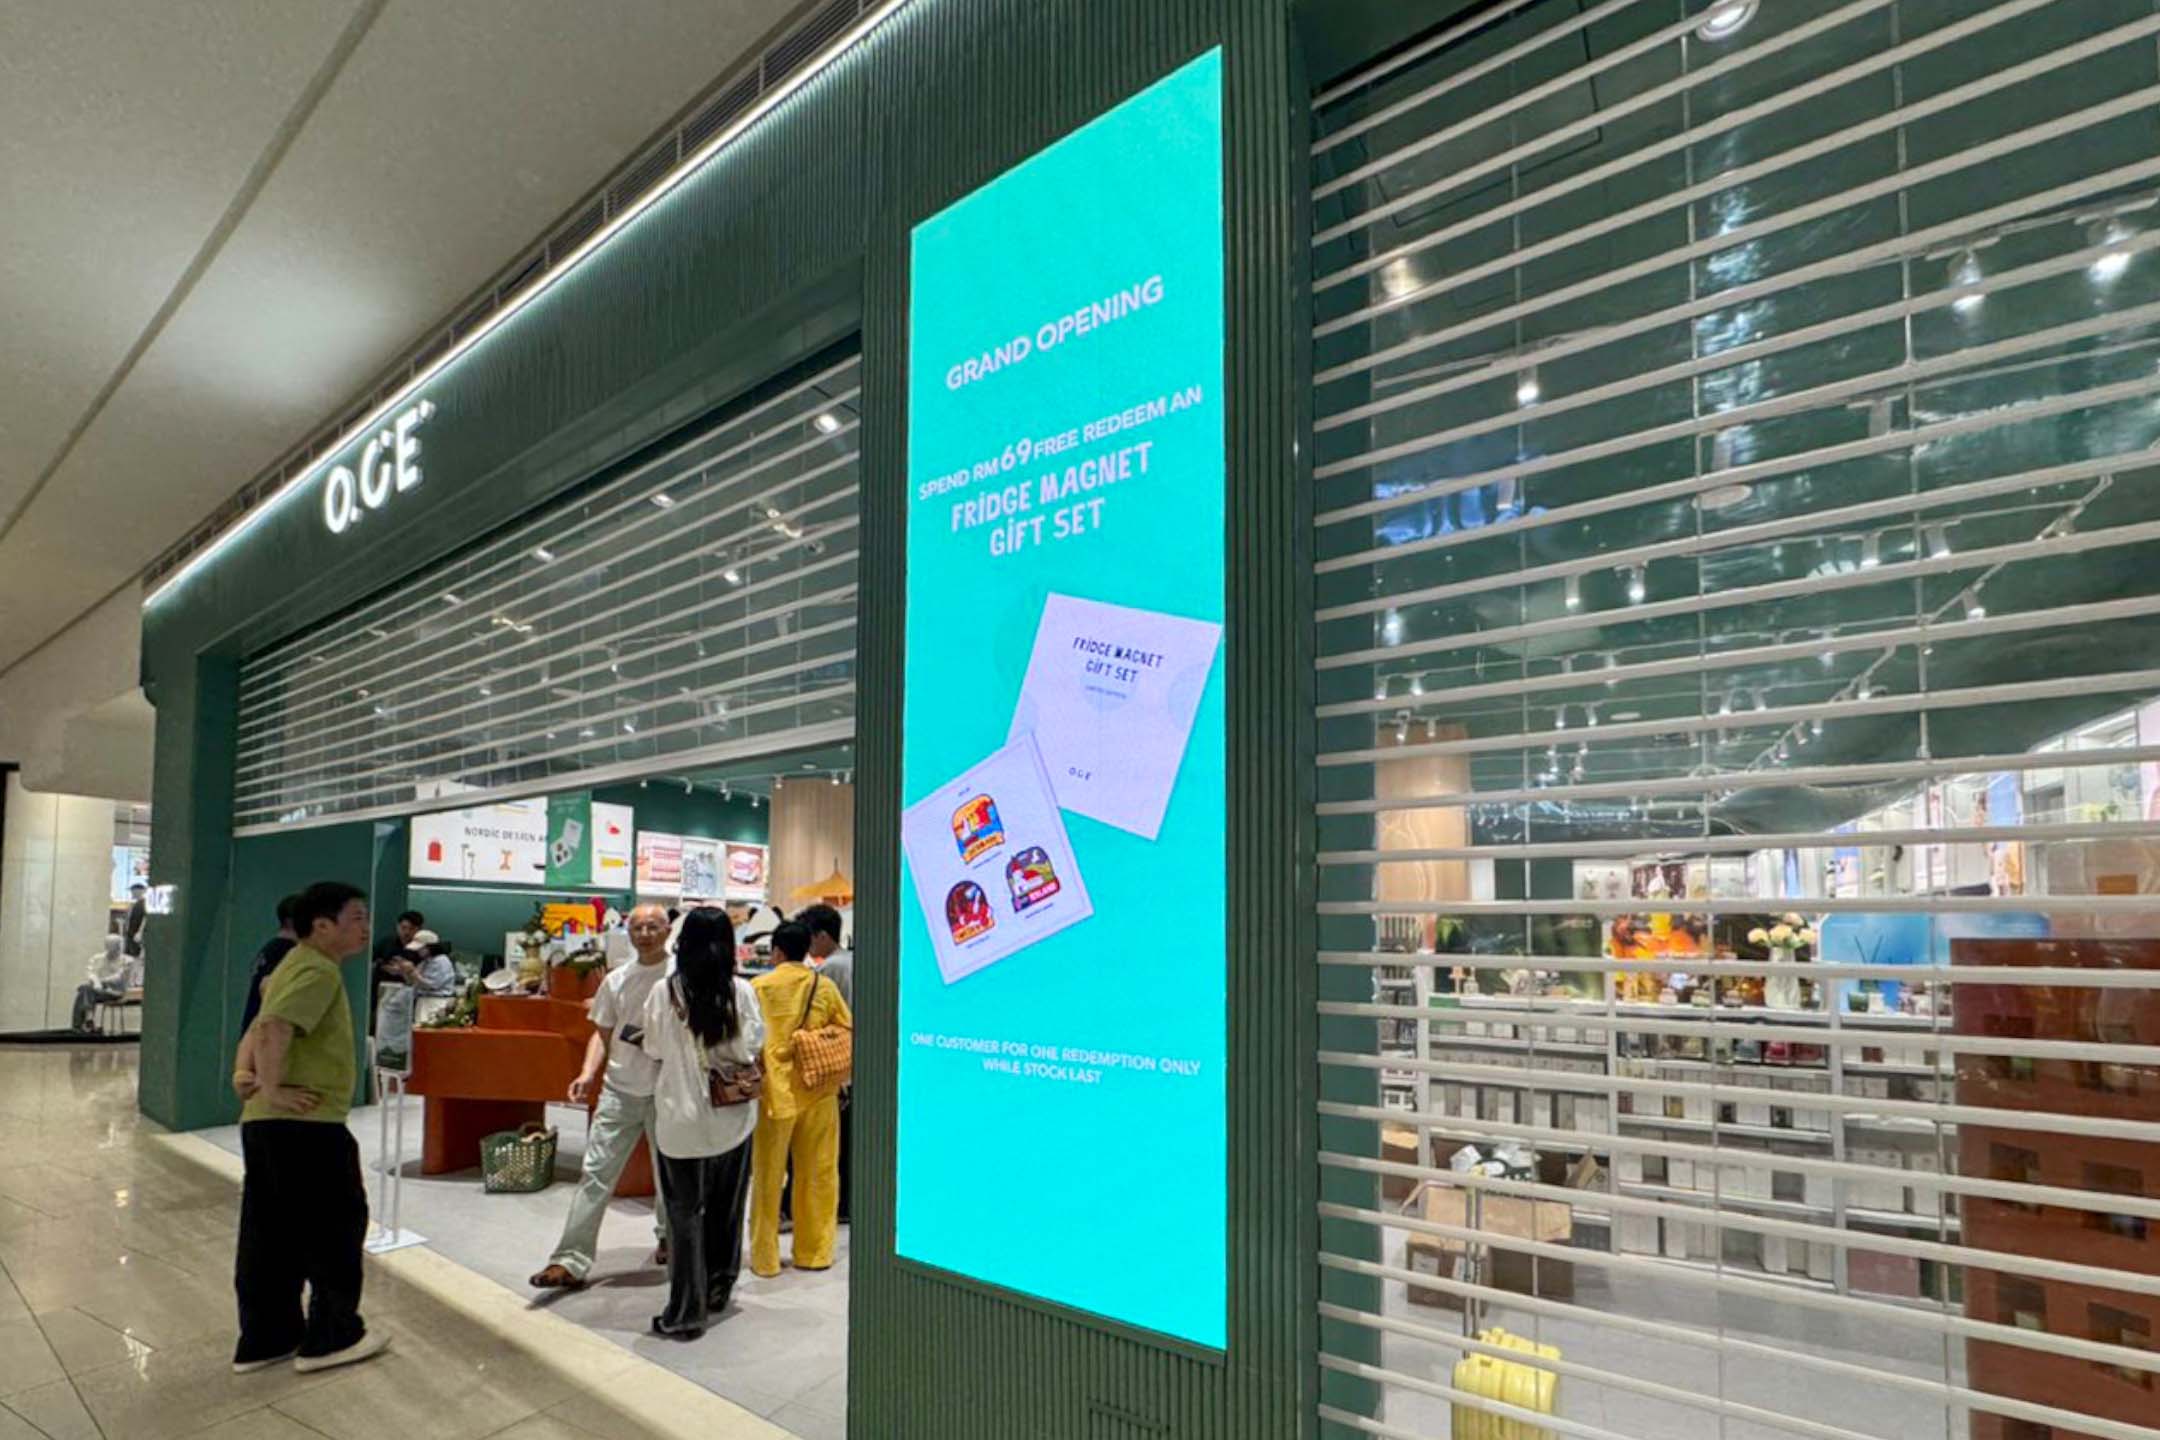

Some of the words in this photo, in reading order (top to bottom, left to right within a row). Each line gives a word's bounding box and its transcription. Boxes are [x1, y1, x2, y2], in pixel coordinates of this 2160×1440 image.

[946, 336, 1031, 390] GRAND
[1036, 274, 1164, 351] OPENING
[919, 468, 969, 500] SPEND
[1033, 429, 1079, 460] FREE
[1083, 397, 1166, 443] REDEEM
[1170, 384, 1202, 414] AN
[1039, 441, 1153, 504] MAGNET
[1053, 497, 1106, 539] SET
[1114, 666, 1138, 683] SET
[911, 1032, 935, 1047] ONE
[936, 1034, 1001, 1055] CUSTOMER
[1002, 1041, 1029, 1057] FOR
[1030, 1044, 1058, 1061] ONE
[1062, 1048, 1156, 1071] REDEMPTION
[1159, 1058, 1201, 1076] ONLY
[983, 1058, 1021, 1075] WHILE
[1024, 1061, 1067, 1081] STOCK
[1069, 1067, 1103, 1084] LAST
